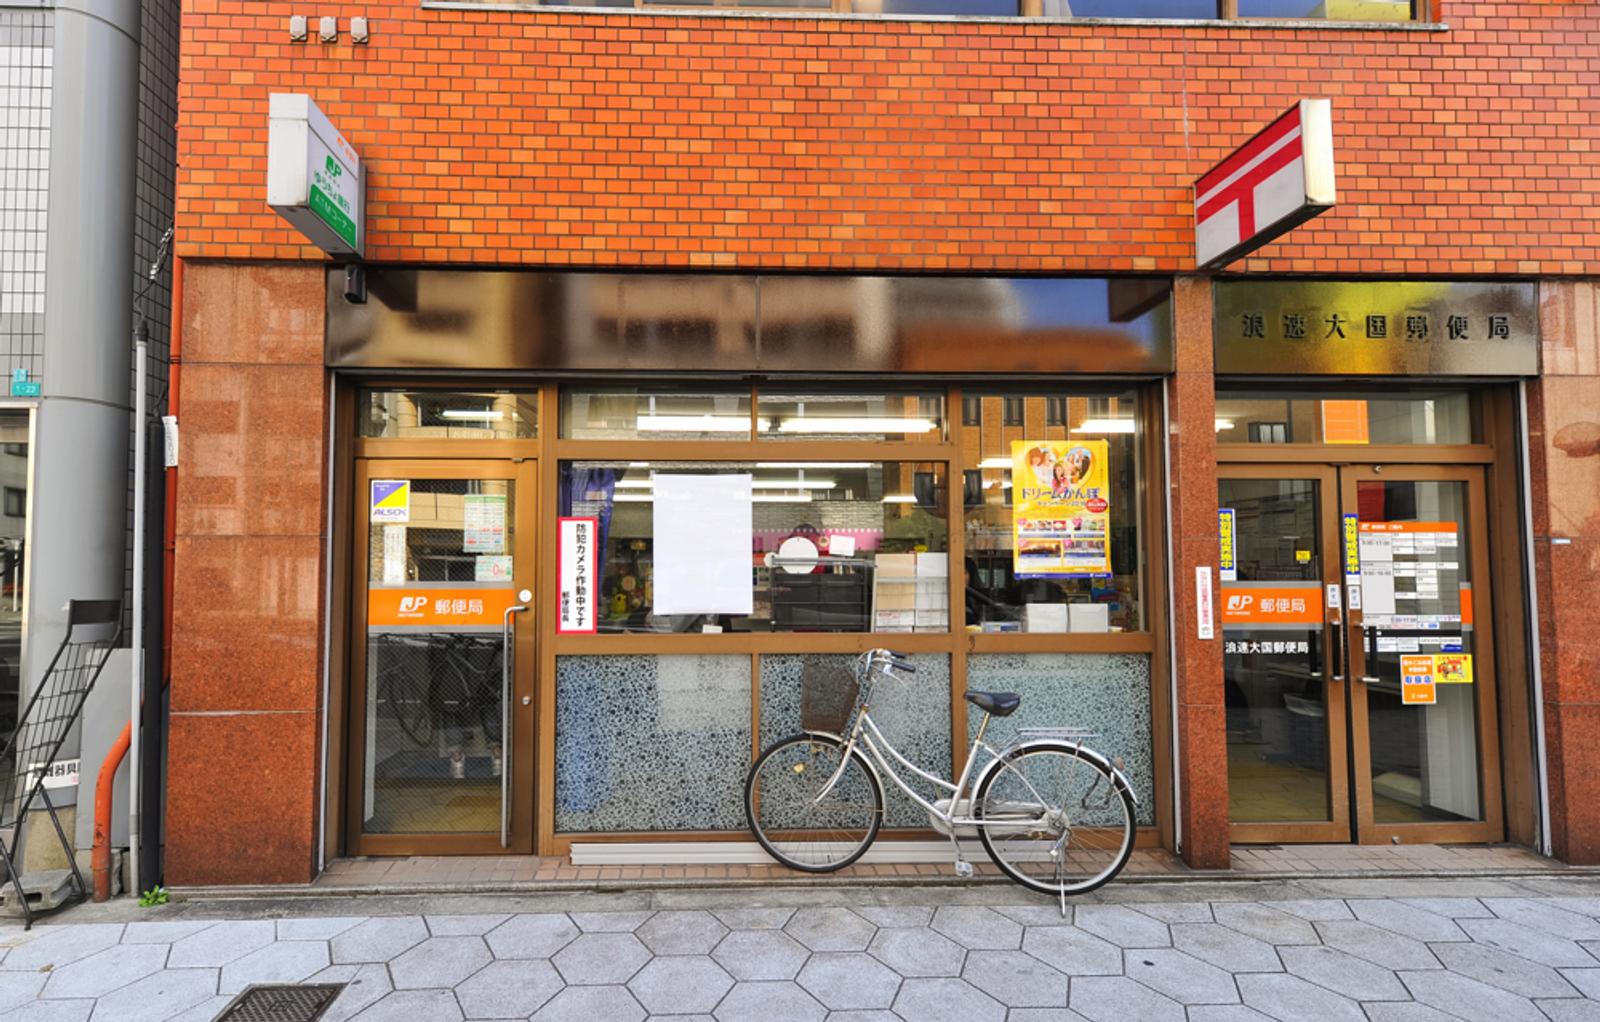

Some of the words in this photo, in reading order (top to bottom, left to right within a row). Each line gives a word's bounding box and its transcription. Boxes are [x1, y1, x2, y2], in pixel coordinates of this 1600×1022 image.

[1242, 313, 1510, 340] 浪速大国郵便局
[373, 508, 407, 517] ALSOK
[576, 523, 587, 627] 防犯カメラ作動中です
[434, 598, 483, 616] 郵便局
[1260, 598, 1306, 613] 郵便局
[1225, 641, 1309, 654] 浪速大国郵便局
